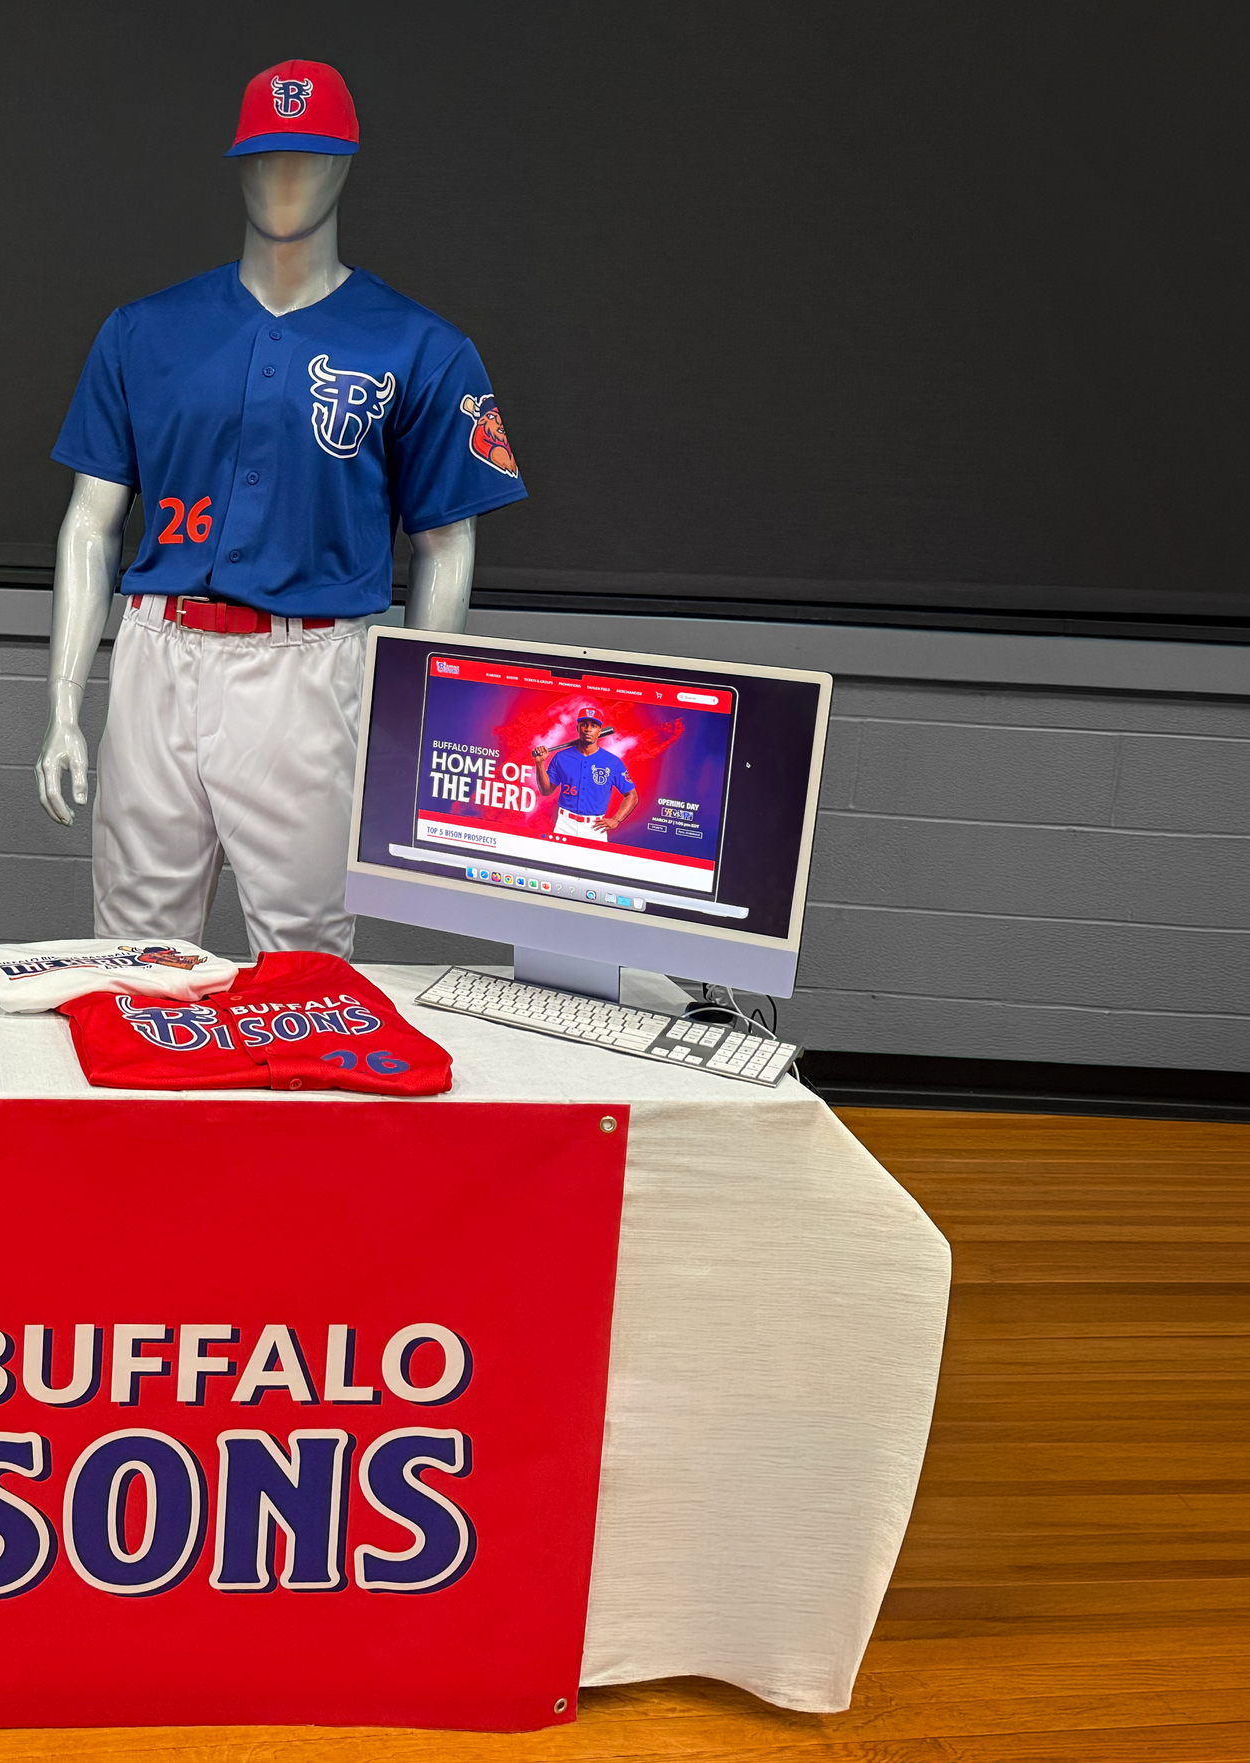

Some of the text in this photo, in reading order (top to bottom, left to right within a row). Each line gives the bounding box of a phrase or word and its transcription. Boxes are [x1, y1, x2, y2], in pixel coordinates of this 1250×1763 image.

[271, 75, 313, 118] B
[307, 354, 396, 459] B
[158, 496, 212, 544] 26
[433, 740, 500, 758] BUFFALO BISONS
[432, 751, 532, 783] HOME OF
[430, 771, 536, 813] THE HERD
[563, 784, 577, 796] 26
[658, 798, 699, 811] OPENING DAY
[427, 827, 438, 835] TOP
[445, 830, 462, 839] BISON
[464, 832, 497, 845] PROSPECTS
[230, 994, 361, 1016] BUFFALO
[115, 995, 382, 1051] BISONS
